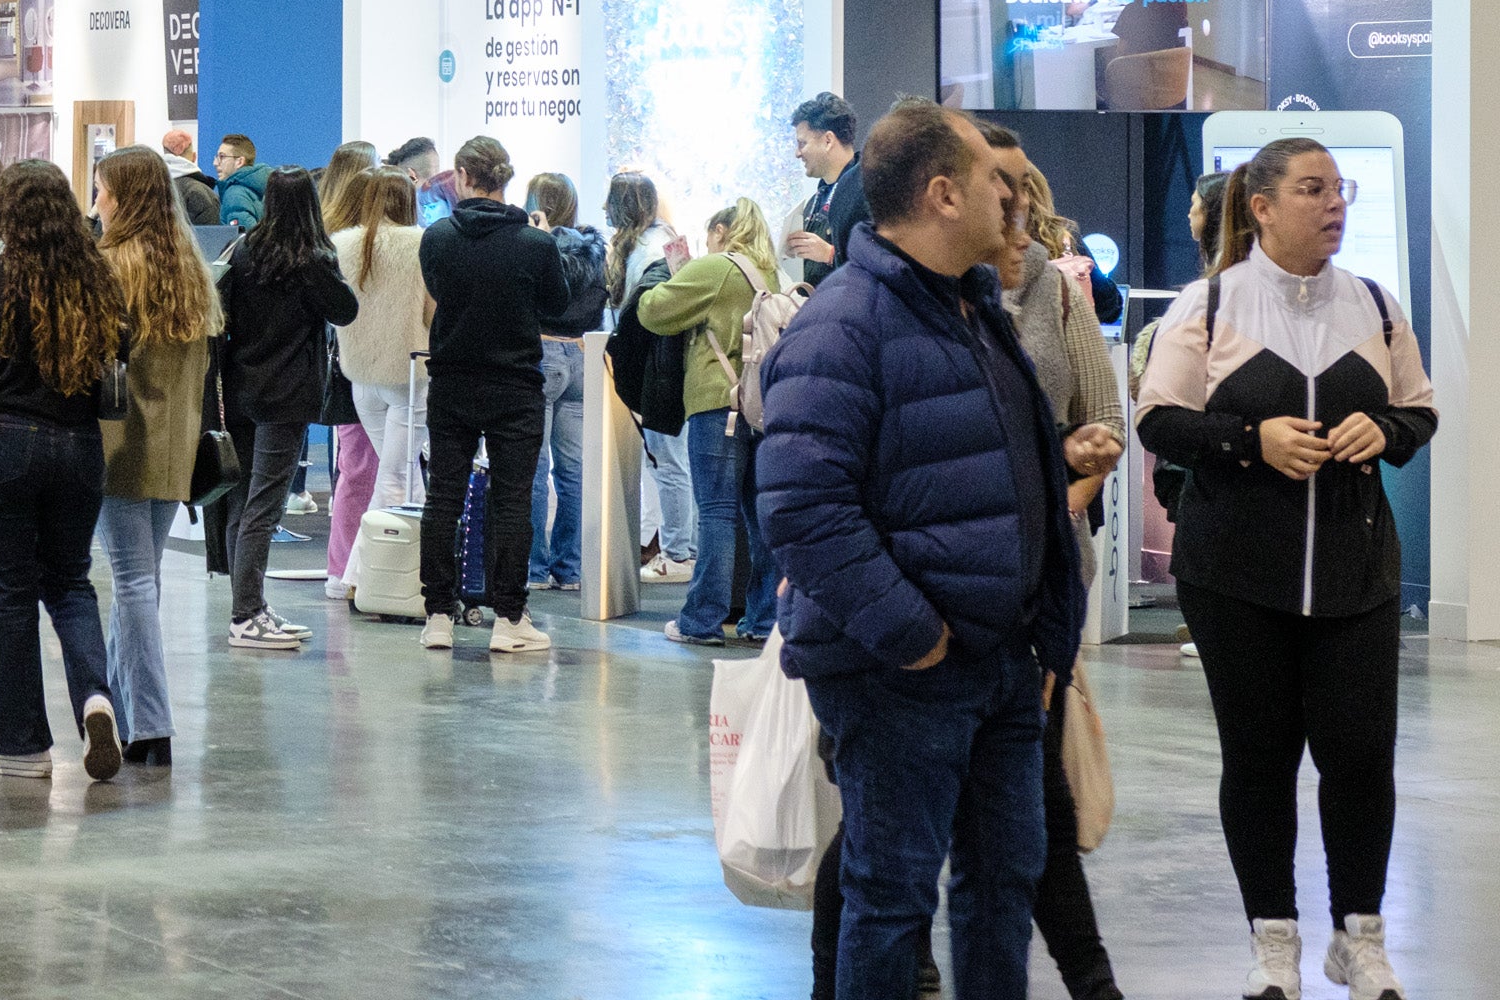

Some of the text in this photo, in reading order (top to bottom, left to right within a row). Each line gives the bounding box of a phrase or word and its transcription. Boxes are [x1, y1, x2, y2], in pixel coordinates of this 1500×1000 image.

[89, 10, 131, 30] DECOVERA
[485, 33, 558, 65] de gestión
[173, 84, 198, 94] FURNI
[485, 68, 580, 95] y reservas on
[485, 100, 518, 125] para
[522, 97, 535, 116] tu
[1295, 93, 1320, 111] BOOKSY
